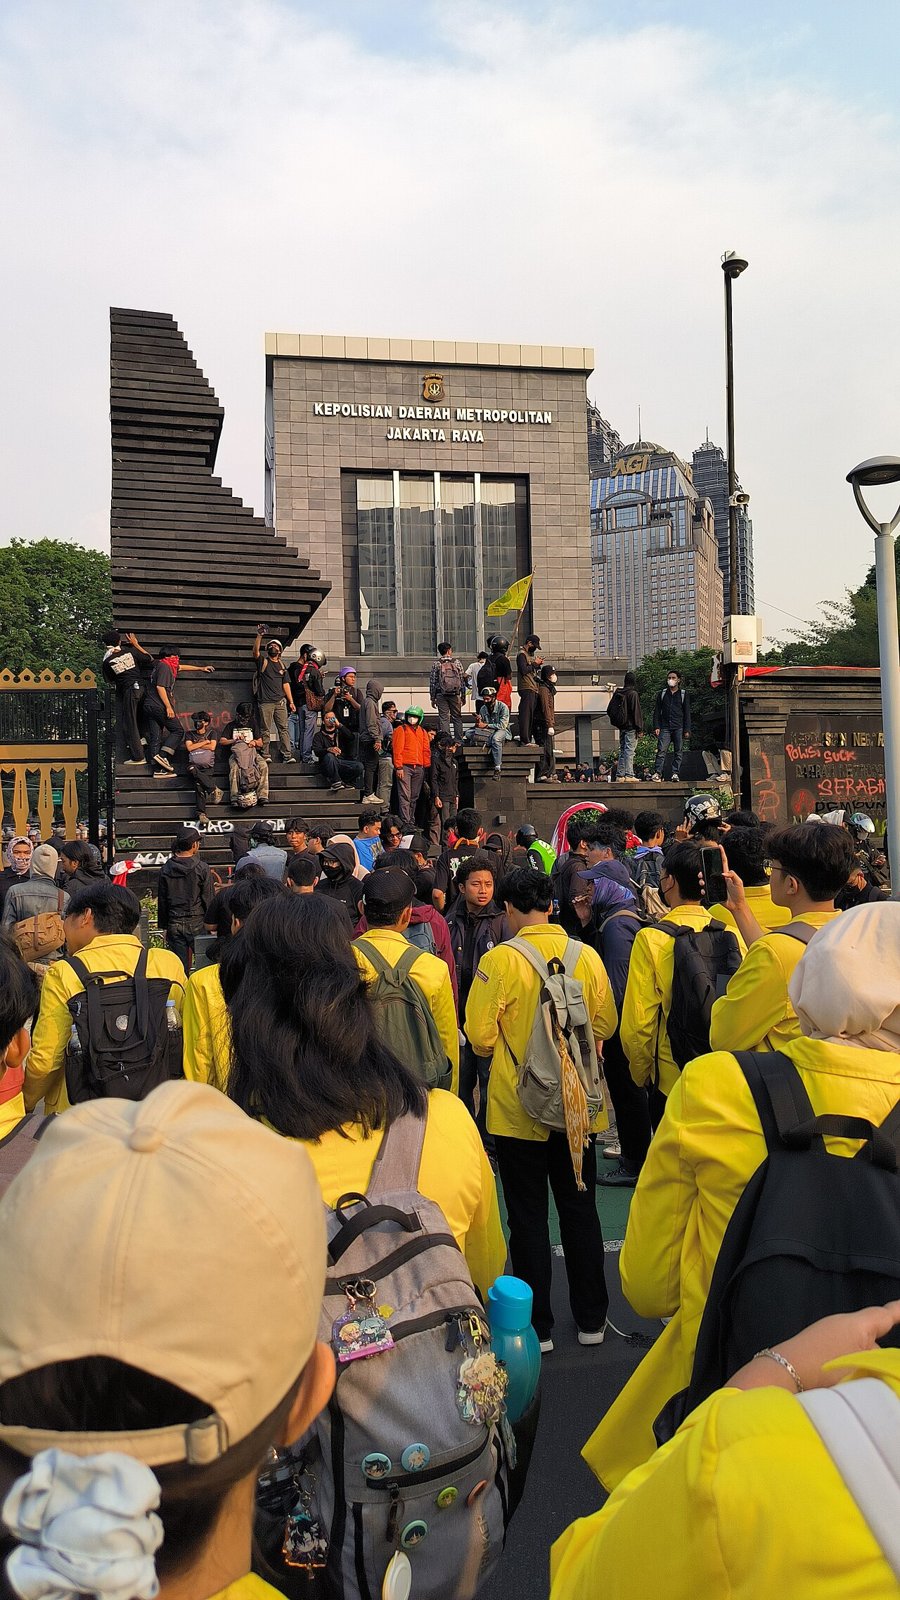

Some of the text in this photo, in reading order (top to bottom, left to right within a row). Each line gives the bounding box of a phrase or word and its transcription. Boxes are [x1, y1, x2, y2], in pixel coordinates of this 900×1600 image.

[314, 402, 552, 424] KEPOLISIAN DAERAH METROPOLITAN
[386, 427, 484, 443] JAKARTA RAYA
[611, 454, 650, 477] AGI
[133, 852, 173, 864] ACA
